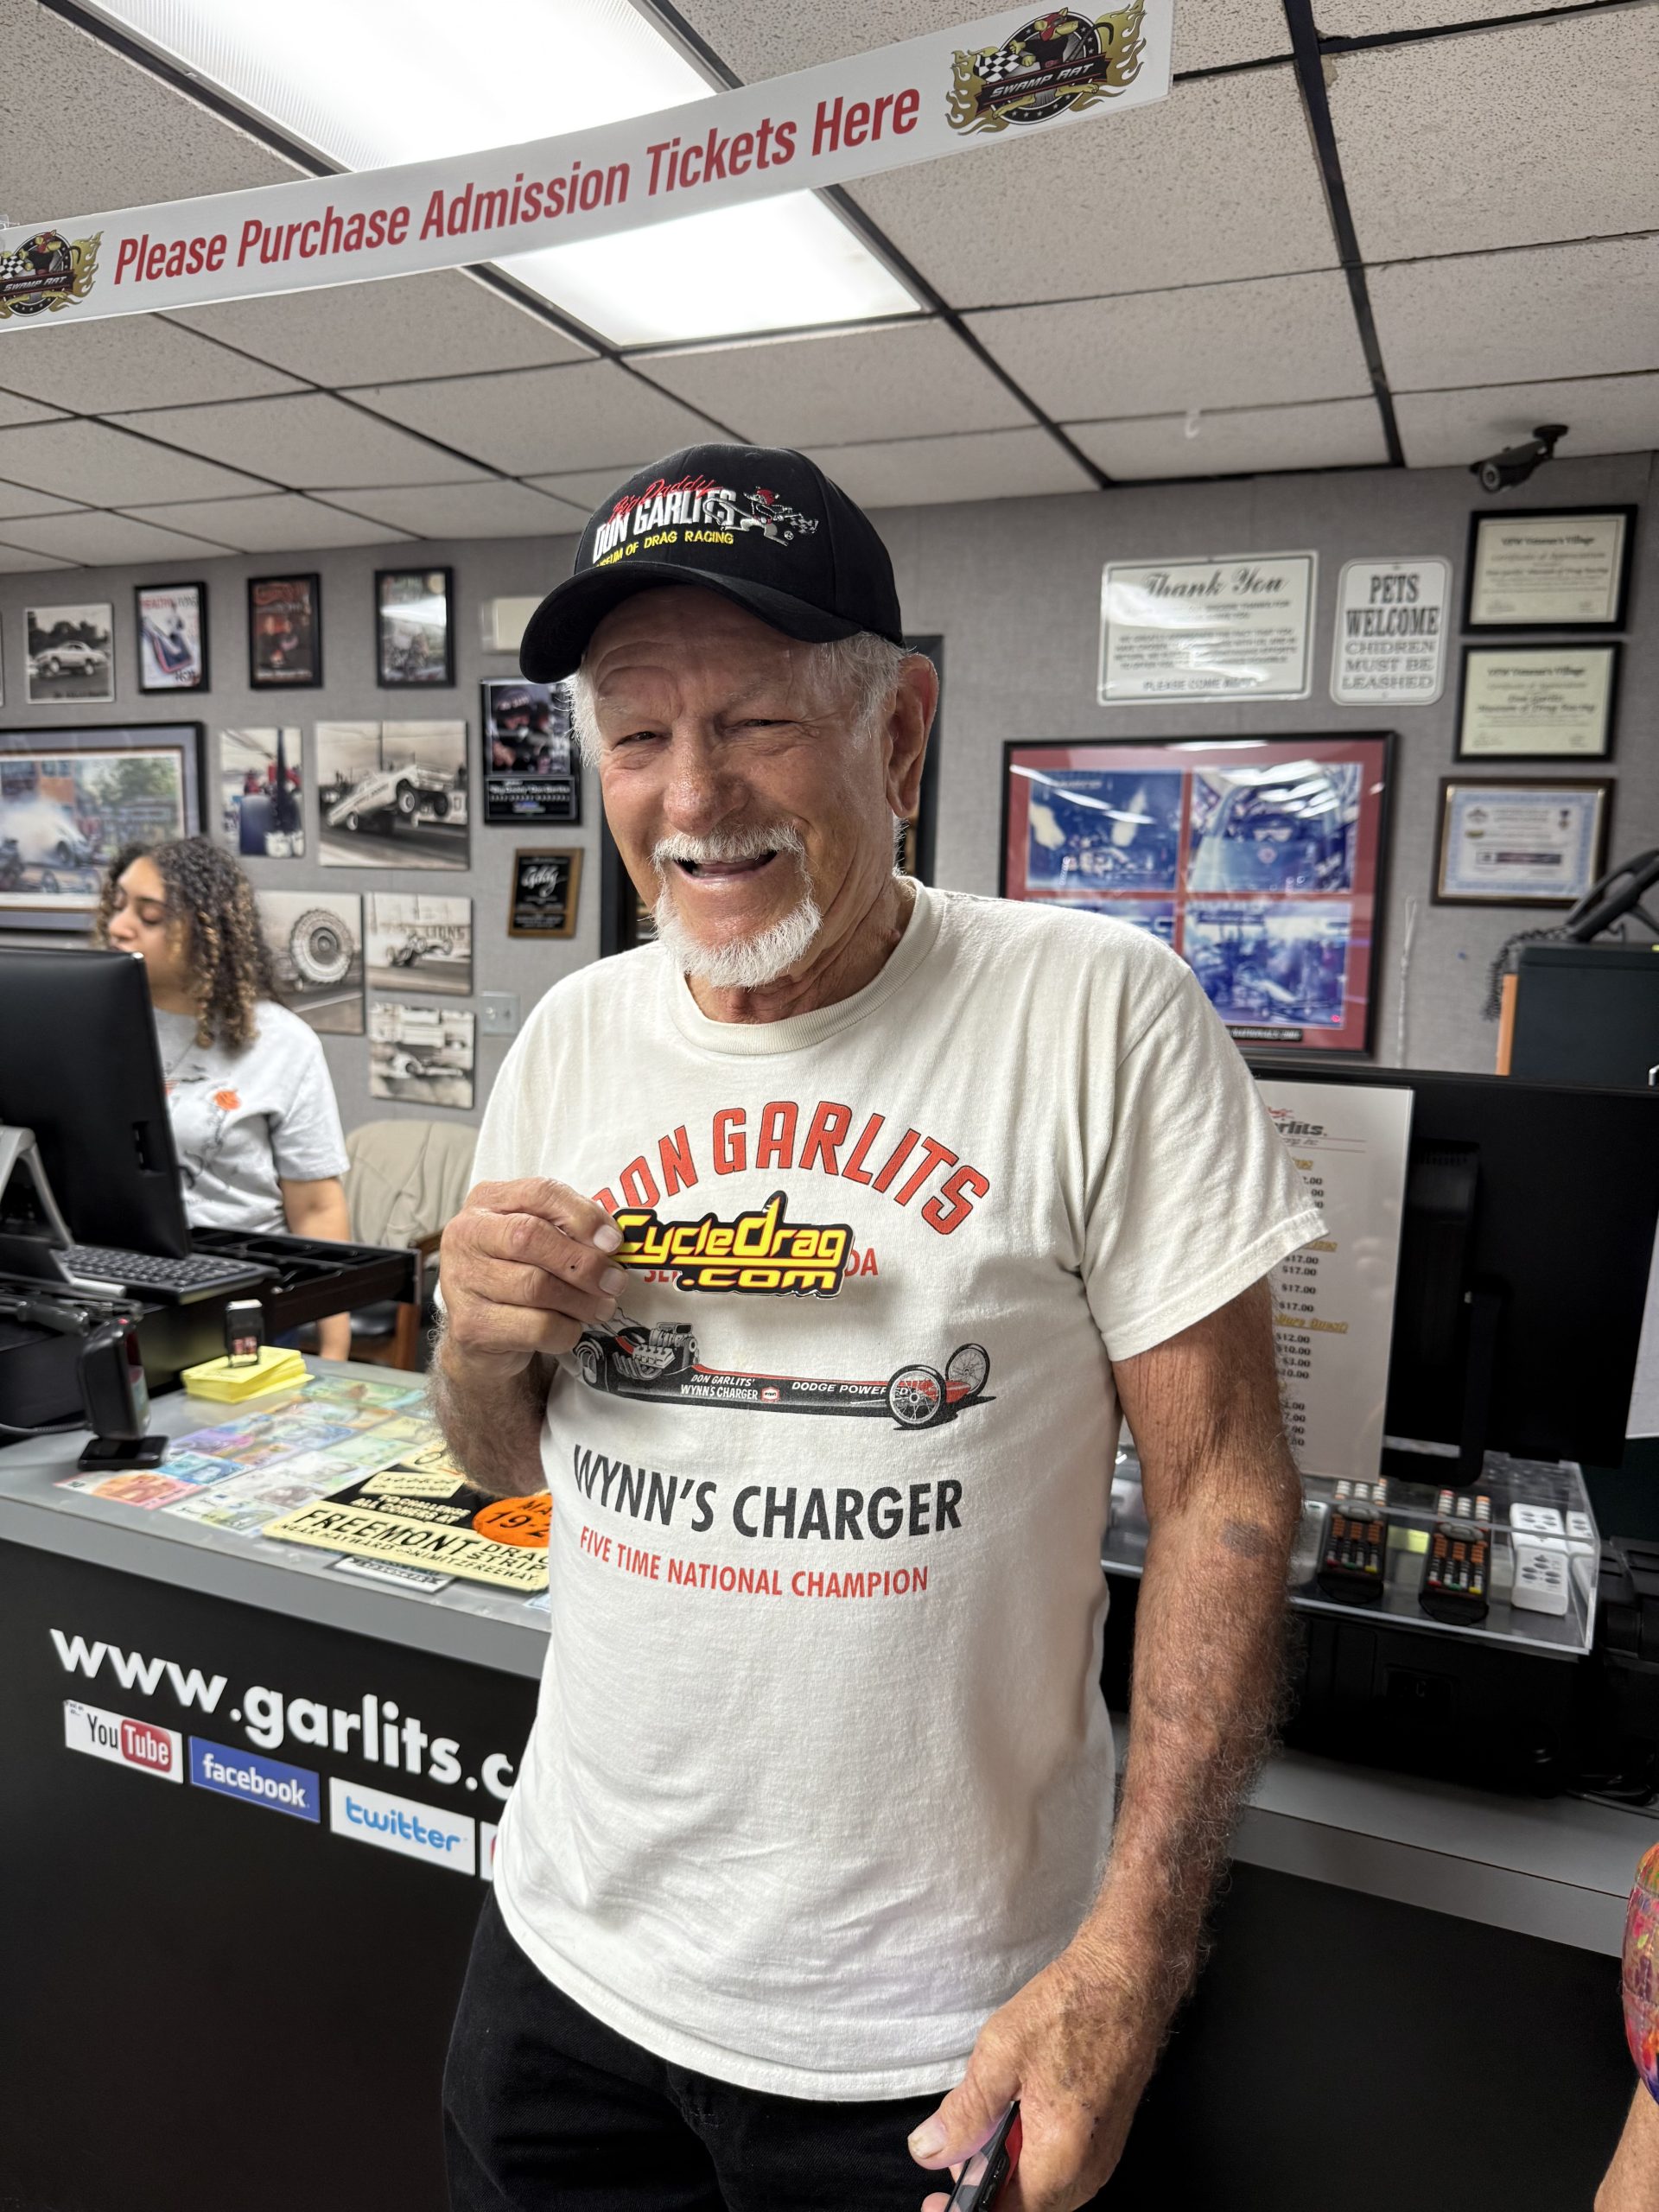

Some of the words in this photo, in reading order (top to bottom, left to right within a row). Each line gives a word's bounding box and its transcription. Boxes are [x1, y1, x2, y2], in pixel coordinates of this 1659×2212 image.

[990, 73, 1053, 99] SWAMP
[1056, 63, 1095, 81] RAT
[114, 234, 227, 285] Please
[237, 205, 410, 267] Purchase
[419, 161, 630, 240] Admission
[645, 117, 798, 195] Tickets
[811, 87, 921, 156] Here
[3, 280, 42, 291] SWAMP
[43, 276, 67, 286] RAT
[640, 475, 724, 506] Daddy
[593, 511, 631, 564] DON
[633, 488, 737, 536] GARLITS
[626, 542, 639, 556] OF
[644, 531, 677, 549] DRAG
[684, 531, 734, 545] RACING
[1141, 568, 1227, 599] Thank
[1230, 567, 1289, 596] You
[1370, 575, 1420, 604] PETS
[1346, 607, 1440, 638] WELCOME
[1345, 657, 1400, 672] MUST
[1405, 657, 1435, 671] BE
[1342, 675, 1434, 690] LEASHED
[713, 1100, 990, 1236] GARLITS
[682, 1268, 838, 1289] .com
[1282, 1265, 1317, 1276] $17.00
[1281, 1283, 1316, 1294] $17.00
[1279, 1300, 1314, 1313] $17.00
[681, 1383, 715, 1397] WYNN'S
[715, 1387, 758, 1401] CHARGER
[690, 1374, 711, 1383] DON
[711, 1375, 755, 1388] GARLITS'
[791, 1382, 836, 1392] DODGE
[574, 1445, 717, 1532] WYNN'S
[732, 1478, 963, 1541] CHARGER
[294, 1510, 481, 1555] FREEMONT
[281, 1524, 317, 1535] NEAR
[319, 1532, 395, 1550] HAYWARD
[464, 1561, 539, 1581] FREEWAY
[467, 1552, 548, 1571] STRIP
[581, 1525, 613, 1562] FIVE
[617, 1543, 661, 1580] TIME
[667, 1558, 783, 1596] NATIONAL
[791, 1566, 929, 1599] CHAMPION
[86, 1713, 169, 1766] YouTube
[202, 1753, 307, 1808] facebook
[346, 1795, 461, 1852] twitter
